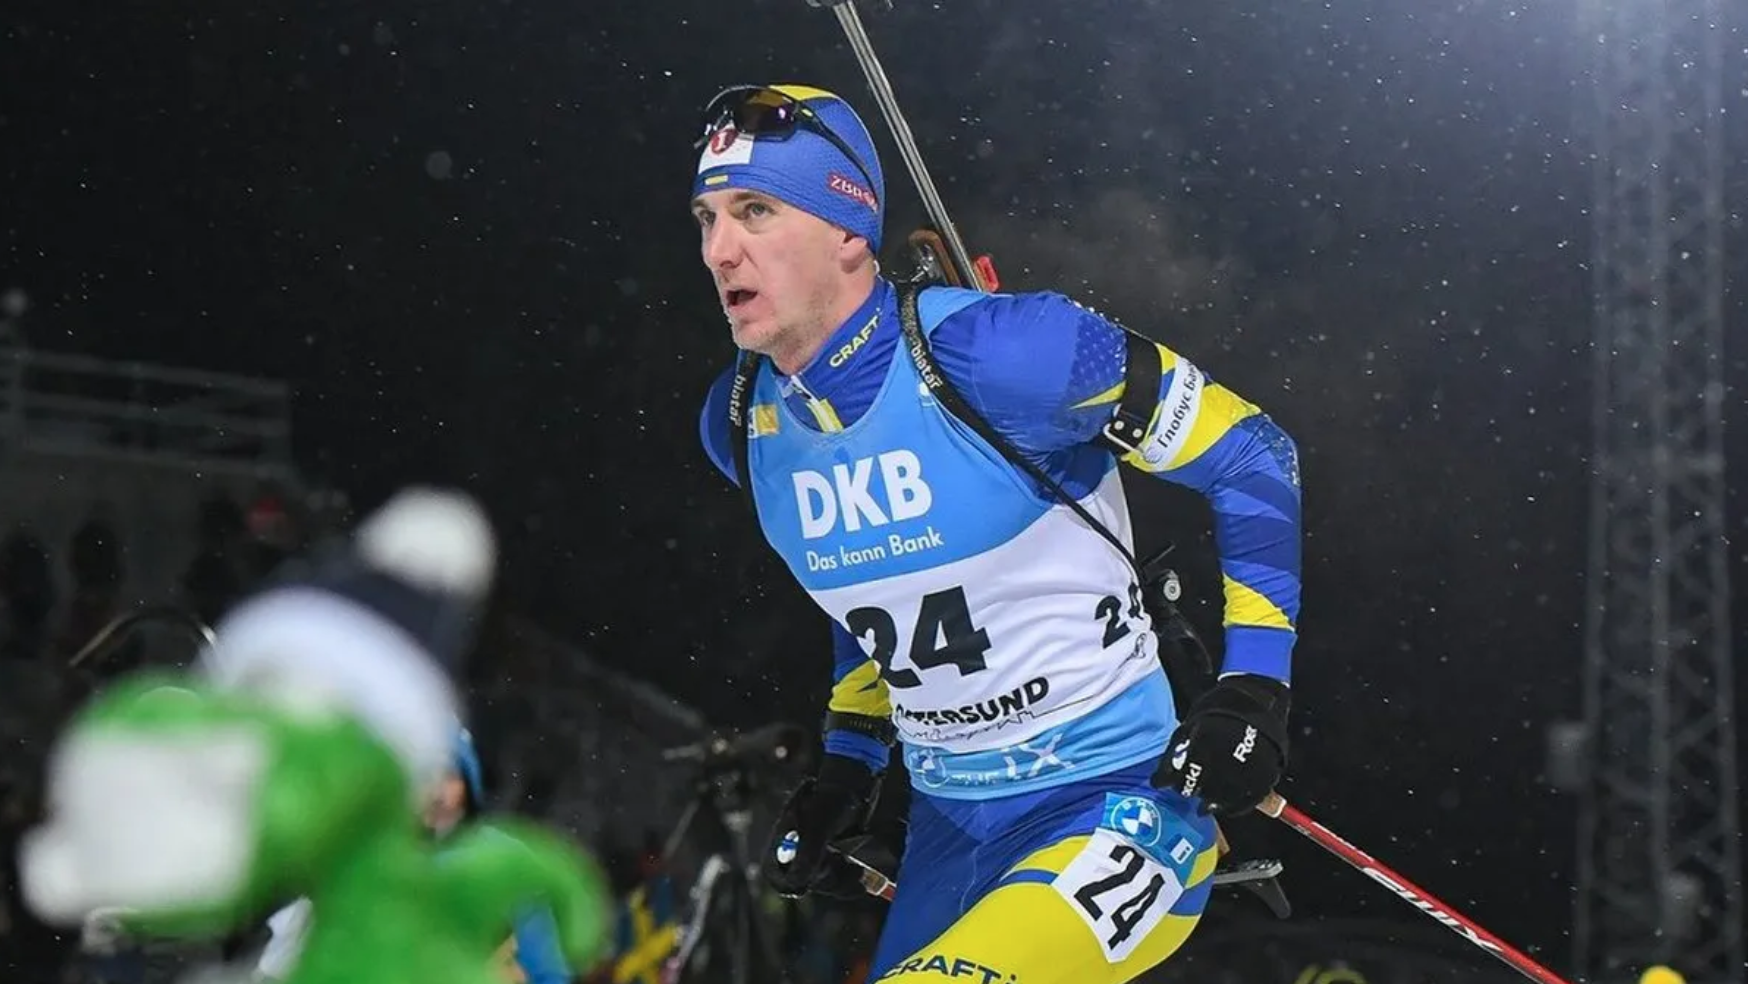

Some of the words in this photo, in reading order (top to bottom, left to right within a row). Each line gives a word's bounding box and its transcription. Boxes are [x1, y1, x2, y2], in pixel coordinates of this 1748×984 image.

[829, 314, 880, 368] CRAFT
[1157, 390, 1192, 448] Глобус
[791, 449, 933, 540] DKB
[806, 550, 838, 571] Das
[840, 546, 886, 567] kann
[888, 526, 944, 557] Bank
[845, 585, 992, 688] 24
[1073, 844, 1166, 951] 24
